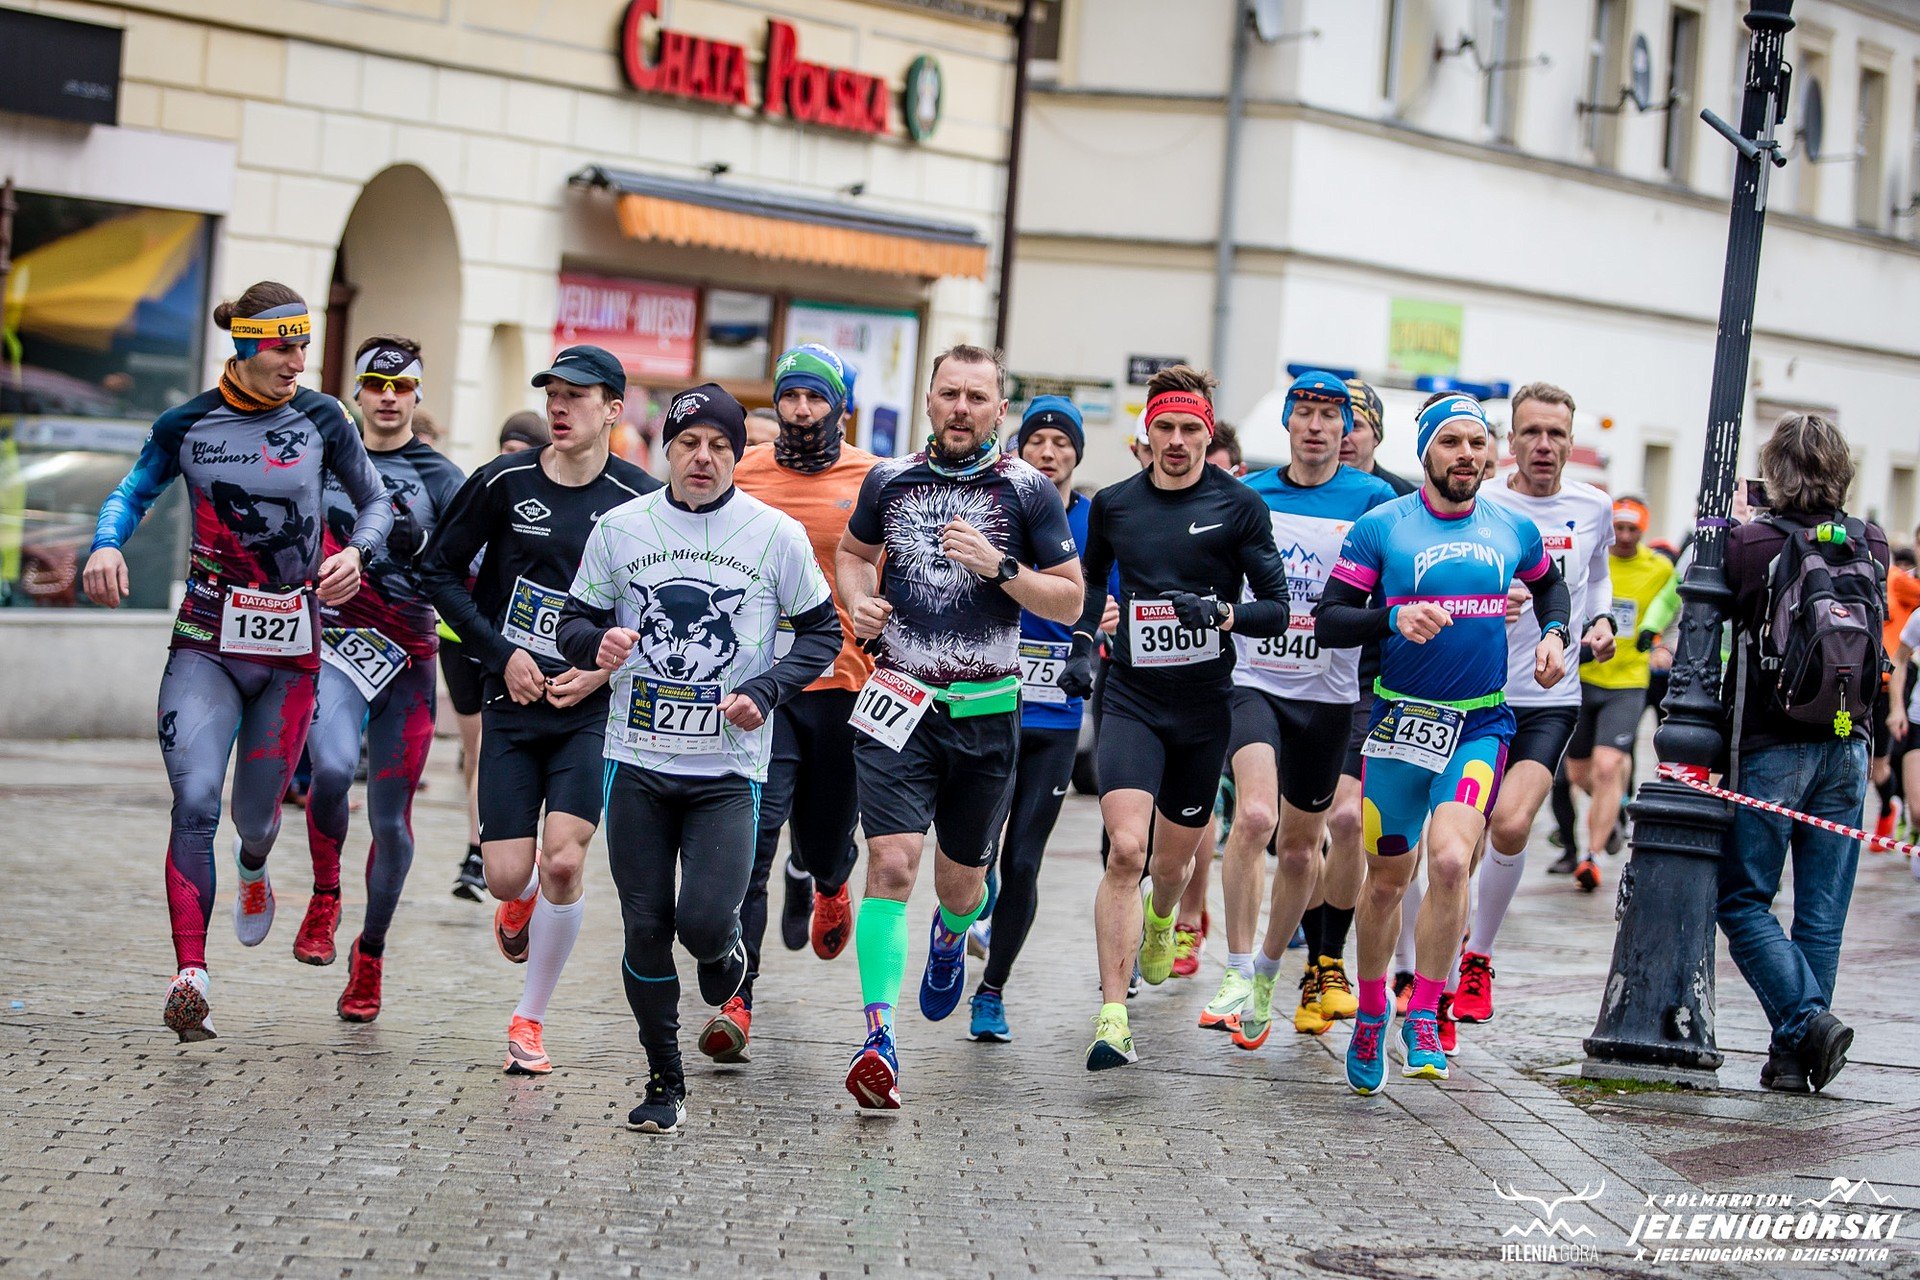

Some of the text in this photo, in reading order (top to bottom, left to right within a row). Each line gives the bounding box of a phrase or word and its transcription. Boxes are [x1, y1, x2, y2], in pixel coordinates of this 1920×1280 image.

[192, 440, 226, 454] Mad
[192, 452, 262, 465] Runners
[627, 549, 761, 582] Wilki Międzylesie
[1414, 541, 1505, 594] BEZSPINY
[239, 595, 297, 609] DATASPORT
[235, 614, 300, 642] 1327
[1140, 625, 1208, 652] 3960
[343, 638, 388, 679] 521
[1257, 634, 1319, 660] 3940
[658, 703, 713, 732] 277
[1399, 718, 1449, 750] 453
